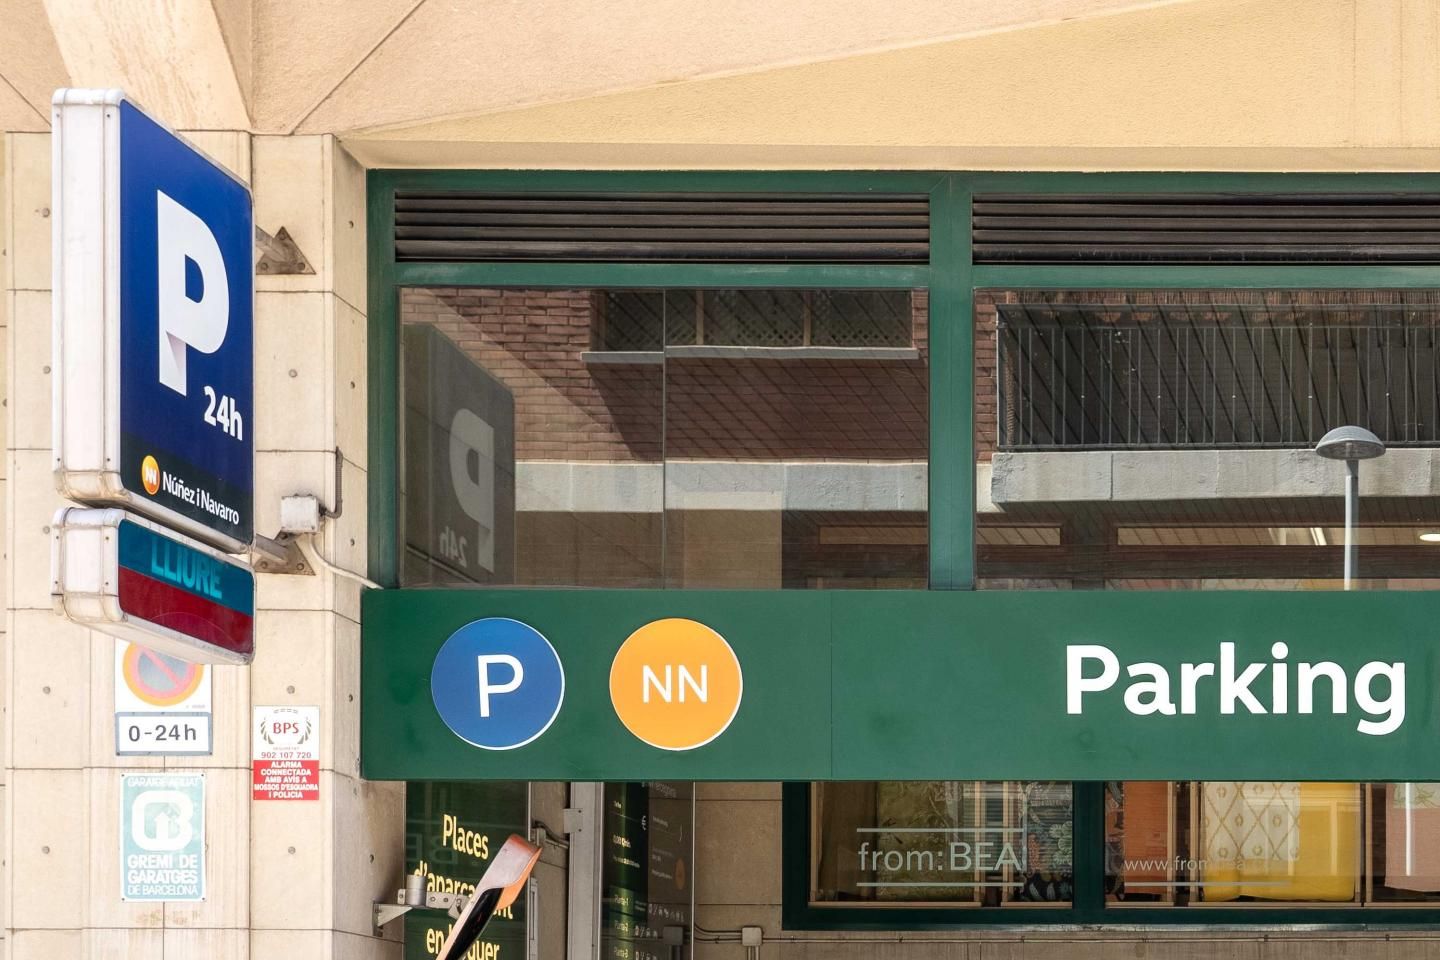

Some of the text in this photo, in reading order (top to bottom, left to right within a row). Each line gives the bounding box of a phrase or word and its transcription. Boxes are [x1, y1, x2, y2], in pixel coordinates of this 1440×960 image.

[157, 189, 230, 397] P
[203, 386, 243, 441] 24h
[162, 471, 240, 526] Núñez i Navarro
[151, 536, 223, 600] LLIURE
[477, 653, 524, 717] P
[642, 664, 708, 703] NN
[1066, 641, 1405, 735] Parking
[272, 722, 300, 735] BPS
[261, 751, 277, 759] 902
[279, 751, 294, 759] 107
[271, 760, 303, 769] ALARMA
[260, 768, 312, 776] CONNECTADA
[264, 776, 281, 784] AMB
[301, 776, 308, 784] A
[254, 783, 280, 791] MOSSOS
[442, 813, 490, 861] Places
[127, 854, 199, 869] GREMI DE
[127, 869, 199, 884] GARATGES
[127, 884, 199, 896] DE BARCELONA
[426, 927, 444, 954] en
